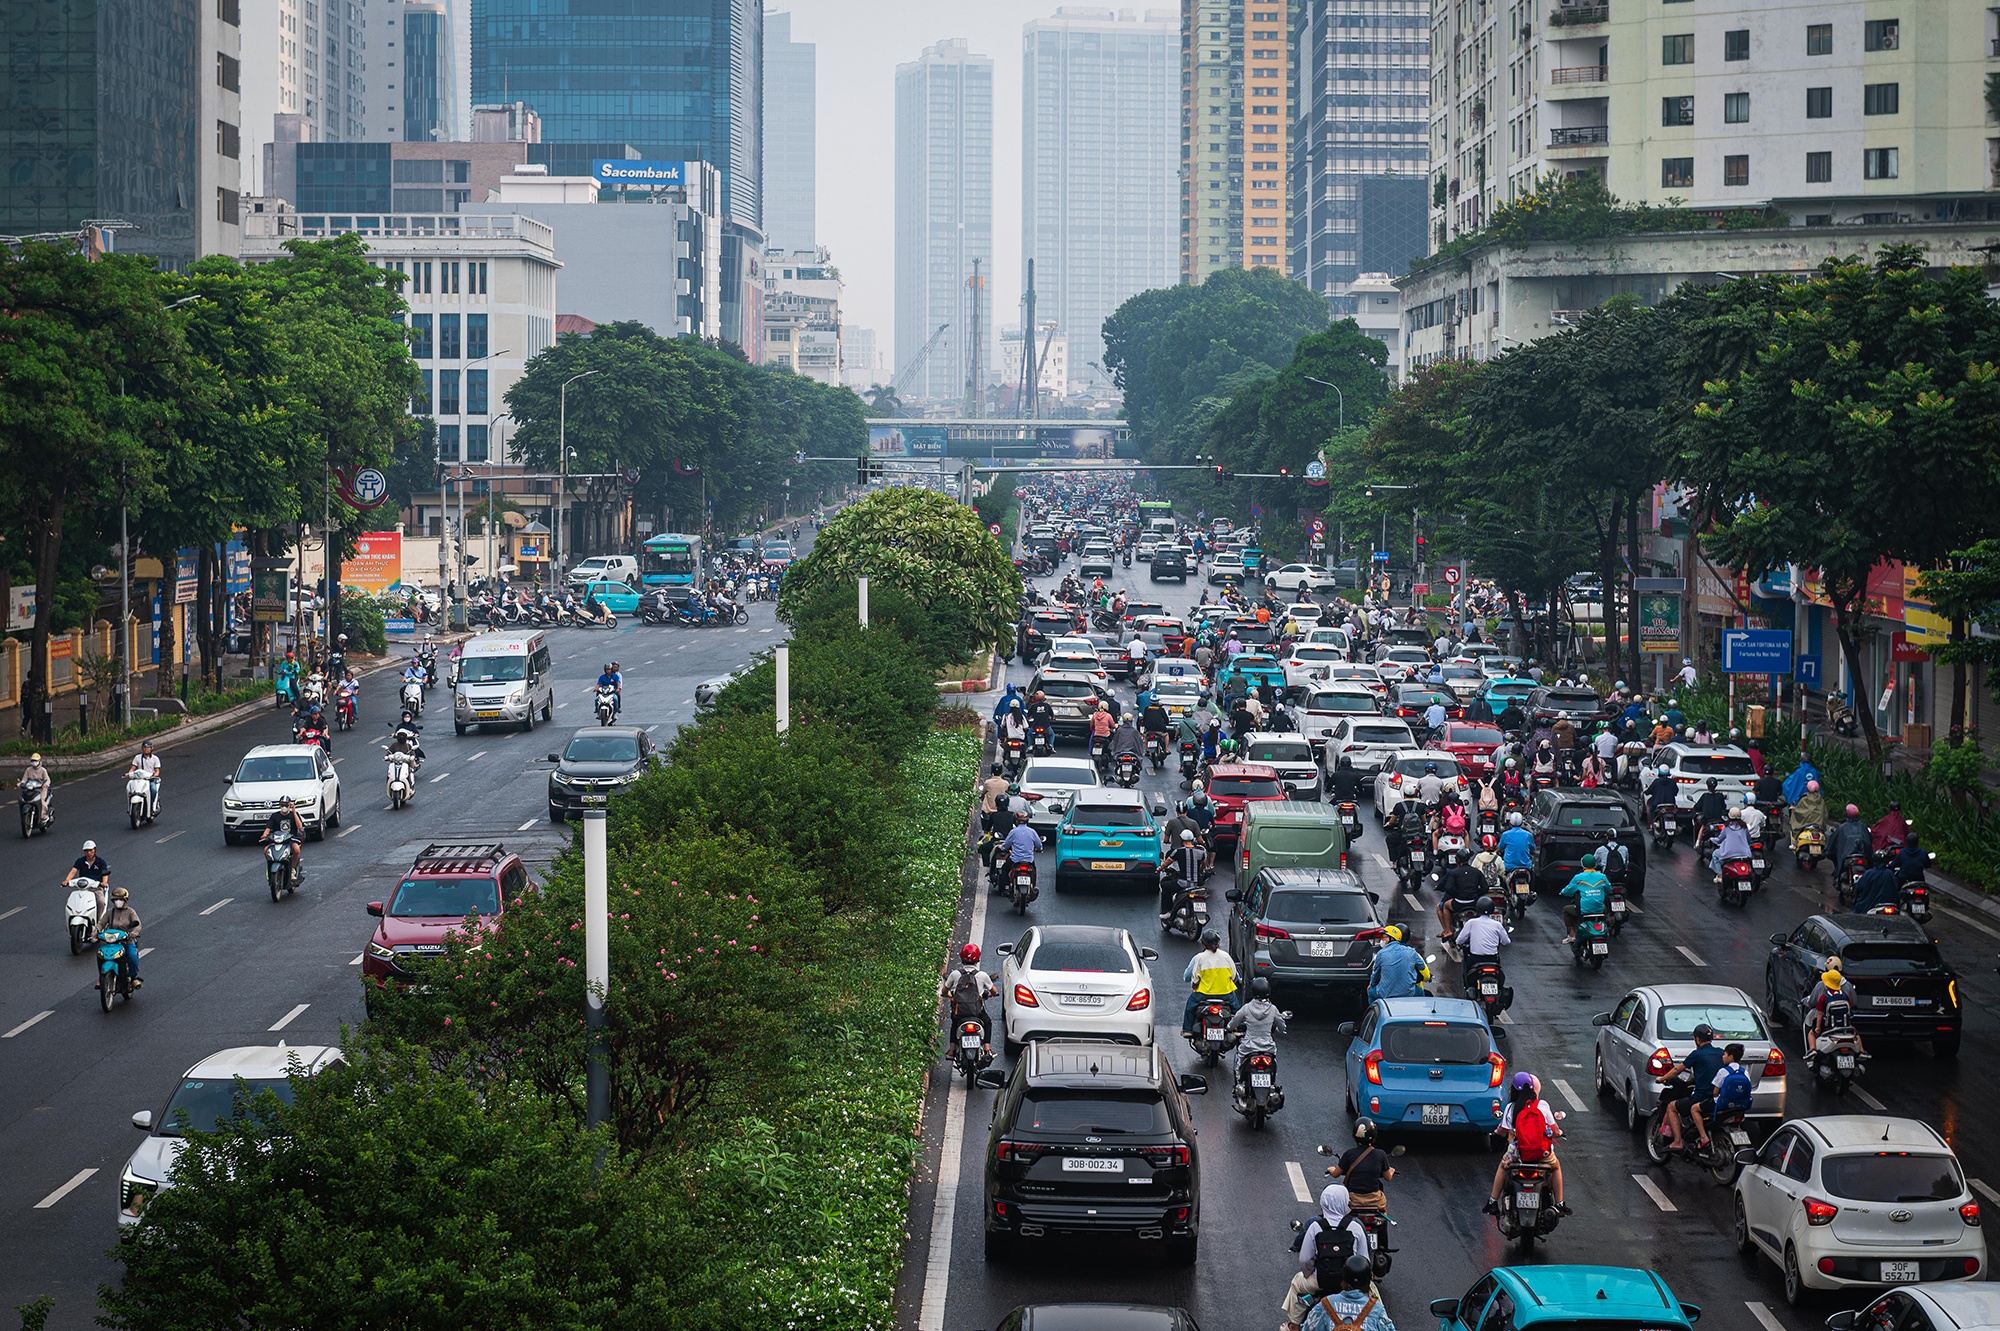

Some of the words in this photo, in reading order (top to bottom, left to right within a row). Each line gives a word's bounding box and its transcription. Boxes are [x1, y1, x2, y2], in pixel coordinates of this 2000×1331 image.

[601, 163, 680, 179] Sacombank
[1428, 1105, 1443, 1115] 29D
[1892, 1262, 1909, 1271] 30F
[1885, 1272, 1916, 1281] 552.77
